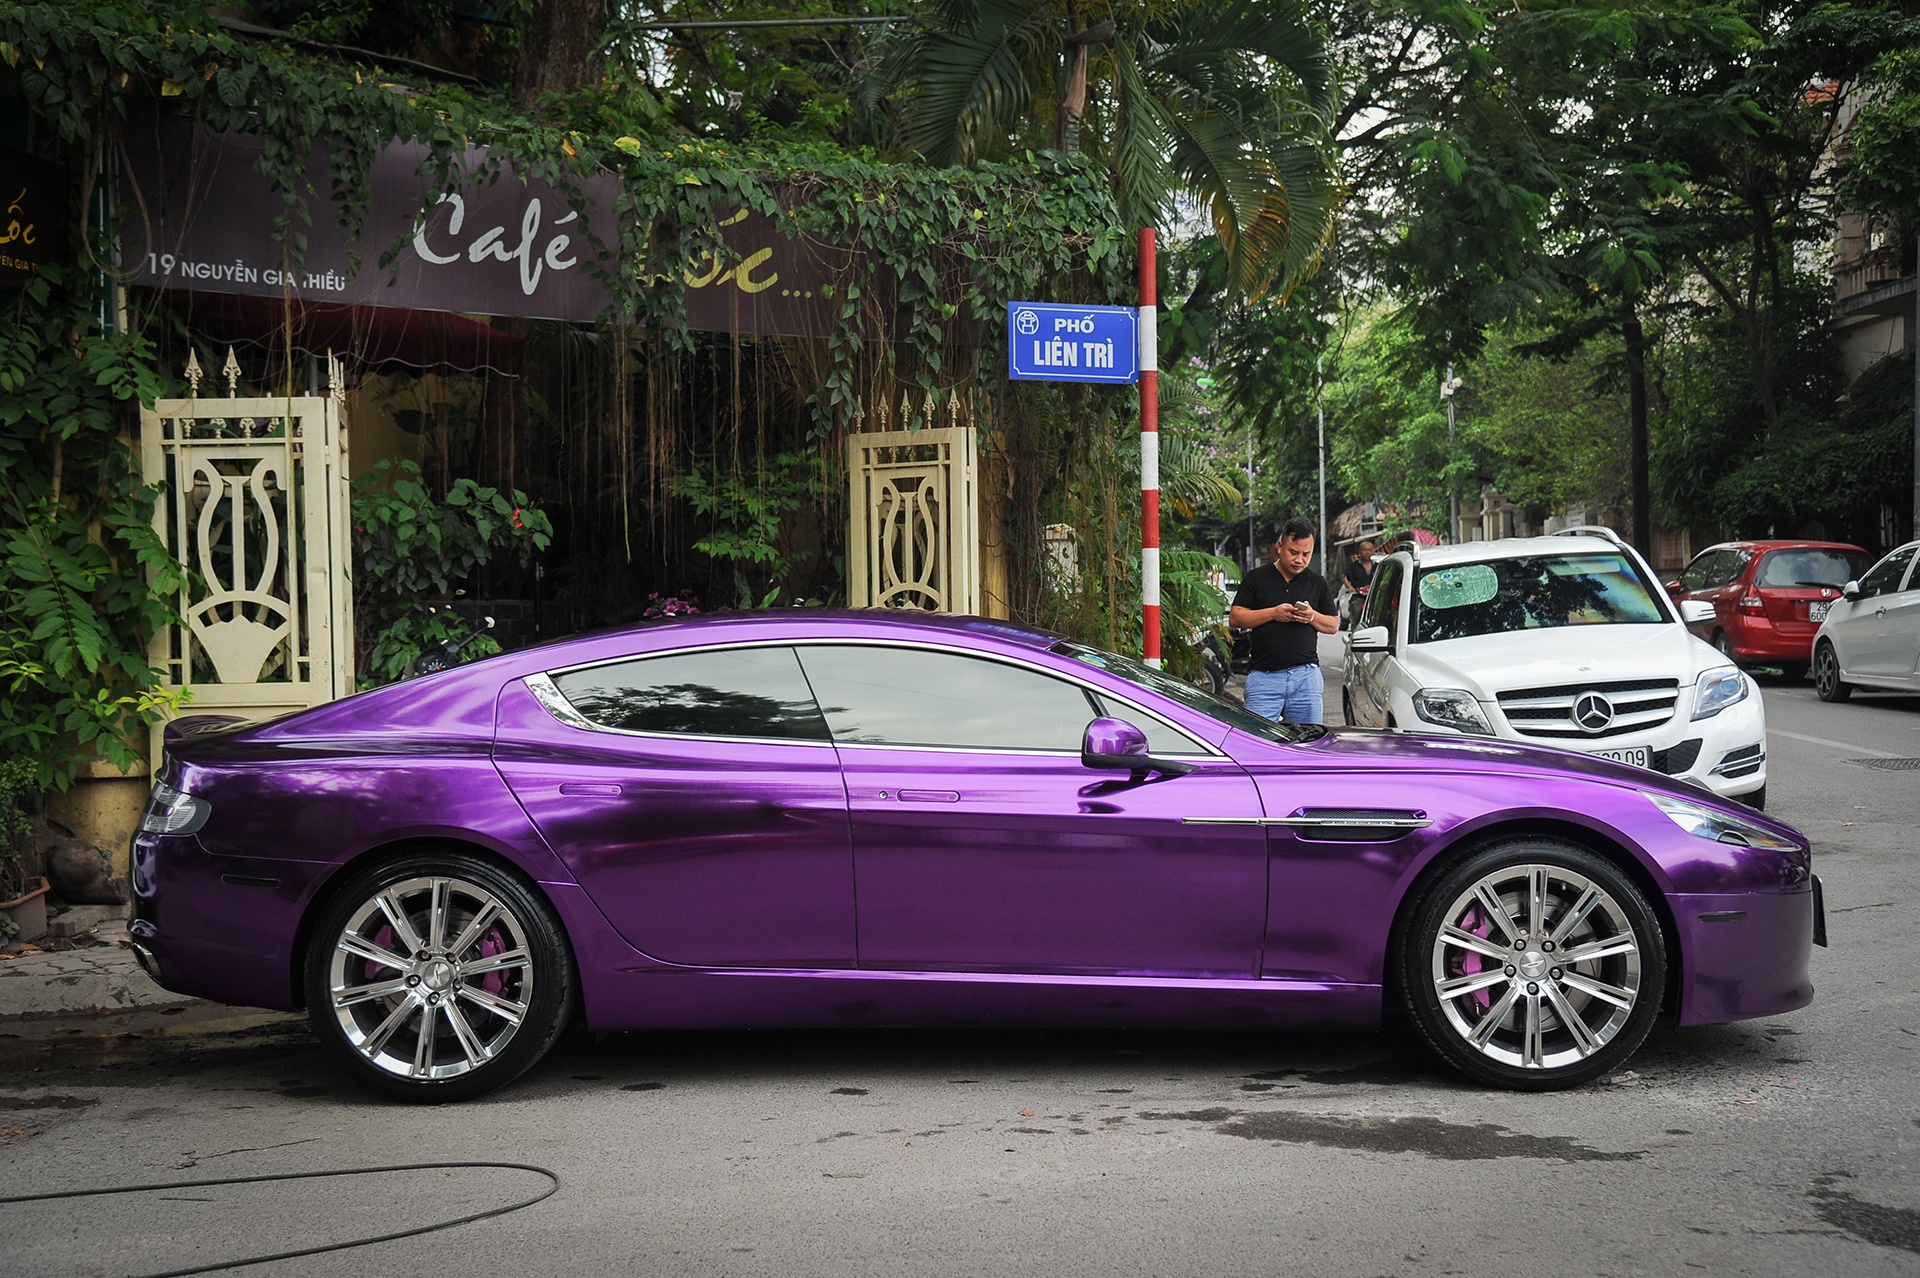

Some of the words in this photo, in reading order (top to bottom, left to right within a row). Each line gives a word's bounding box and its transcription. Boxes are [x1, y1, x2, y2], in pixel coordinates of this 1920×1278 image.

[0, 187, 36, 245] ốc
[412, 192, 578, 295] Café
[149, 252, 176, 275] 19
[181, 259, 257, 284] NGUYỄN
[262, 269, 296, 287] GIA
[1054, 314, 1095, 334] PHỐ
[1033, 335, 1078, 367] LIÊN
[1083, 337, 1114, 369] TRÌ
